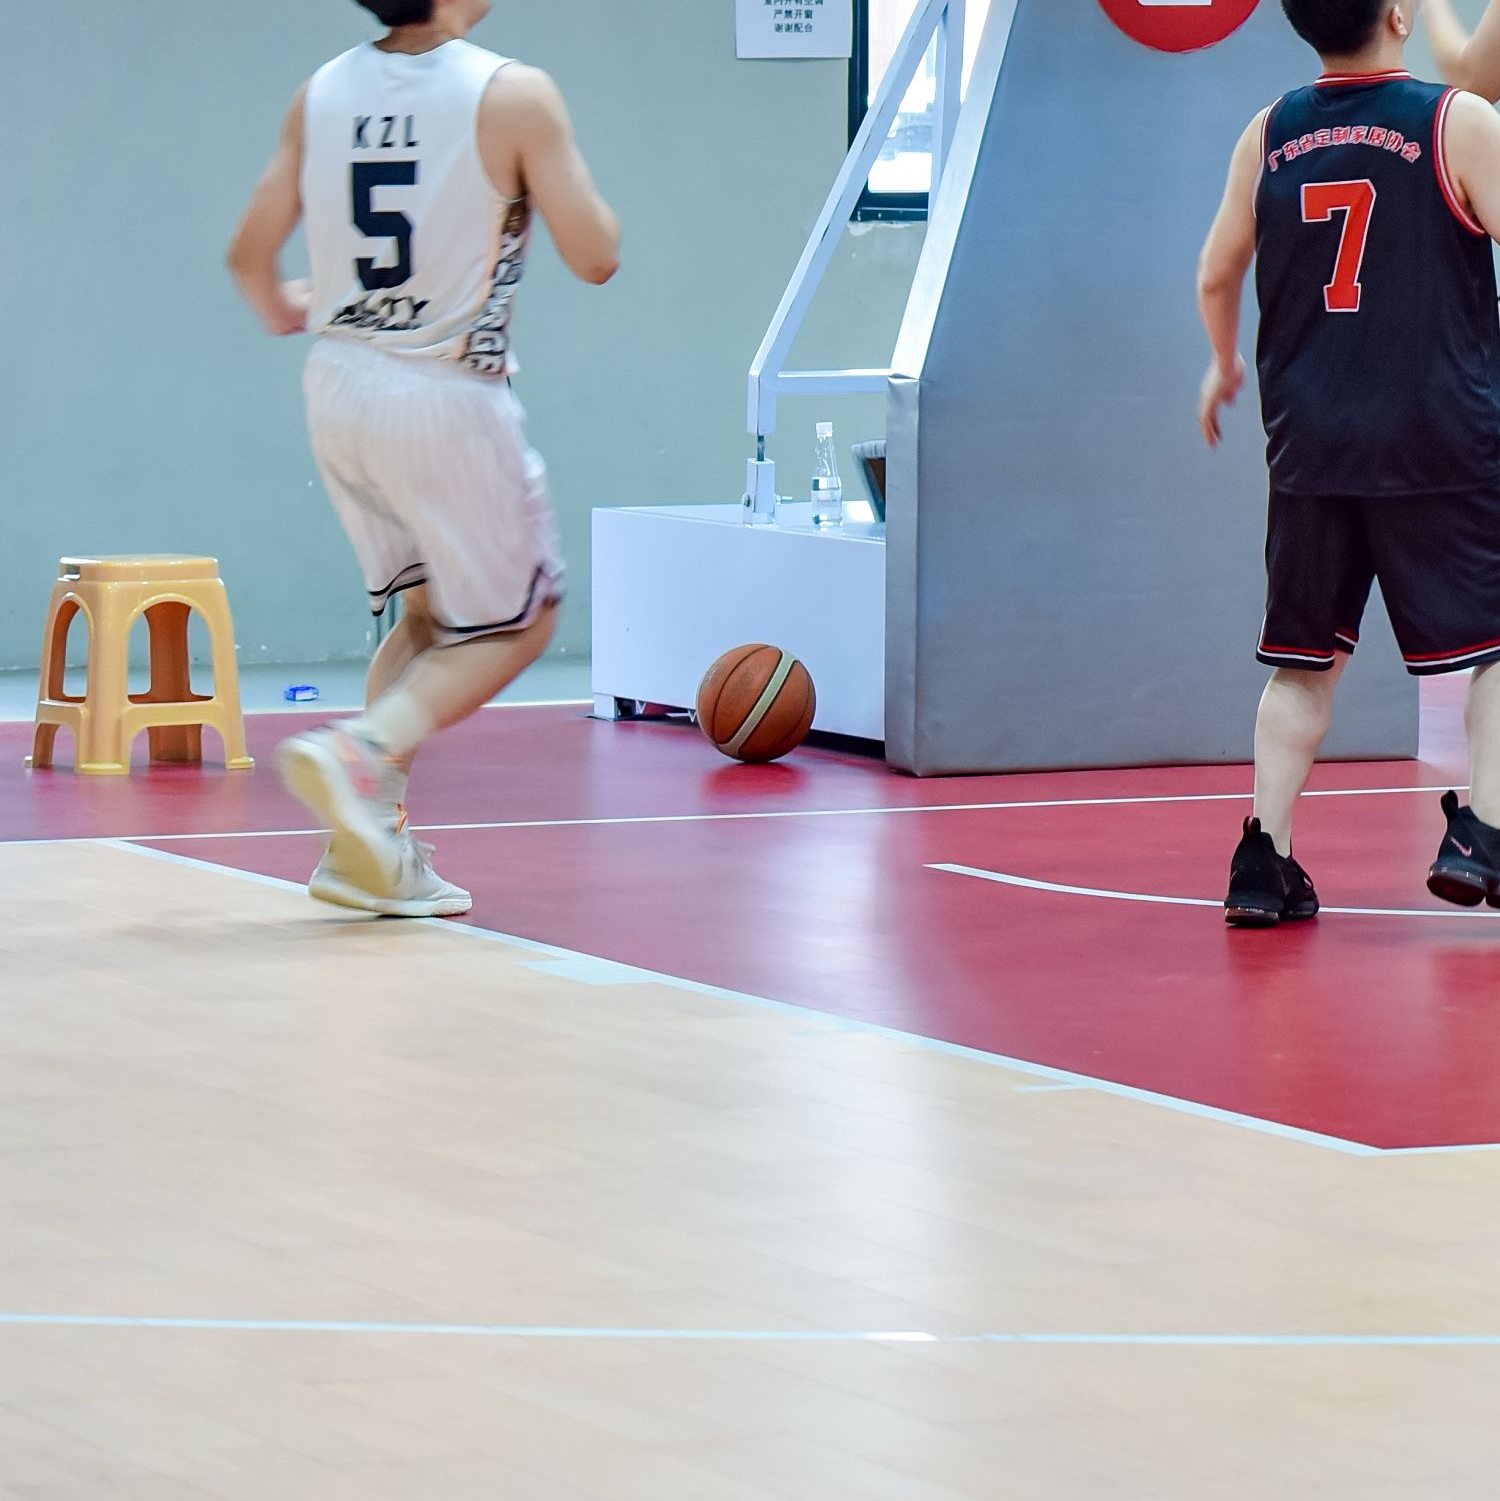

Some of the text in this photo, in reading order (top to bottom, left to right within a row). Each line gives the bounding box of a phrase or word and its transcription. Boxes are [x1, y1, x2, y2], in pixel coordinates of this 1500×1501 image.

[773, 9, 813, 19] 严禁开窗
[774, 22, 814, 33] 谢谢配合
[352, 114, 420, 149] KZL
[1268, 125, 1422, 173] 广东省定制家居协会
[351, 160, 420, 291] 5
[1300, 178, 1377, 313] 7
